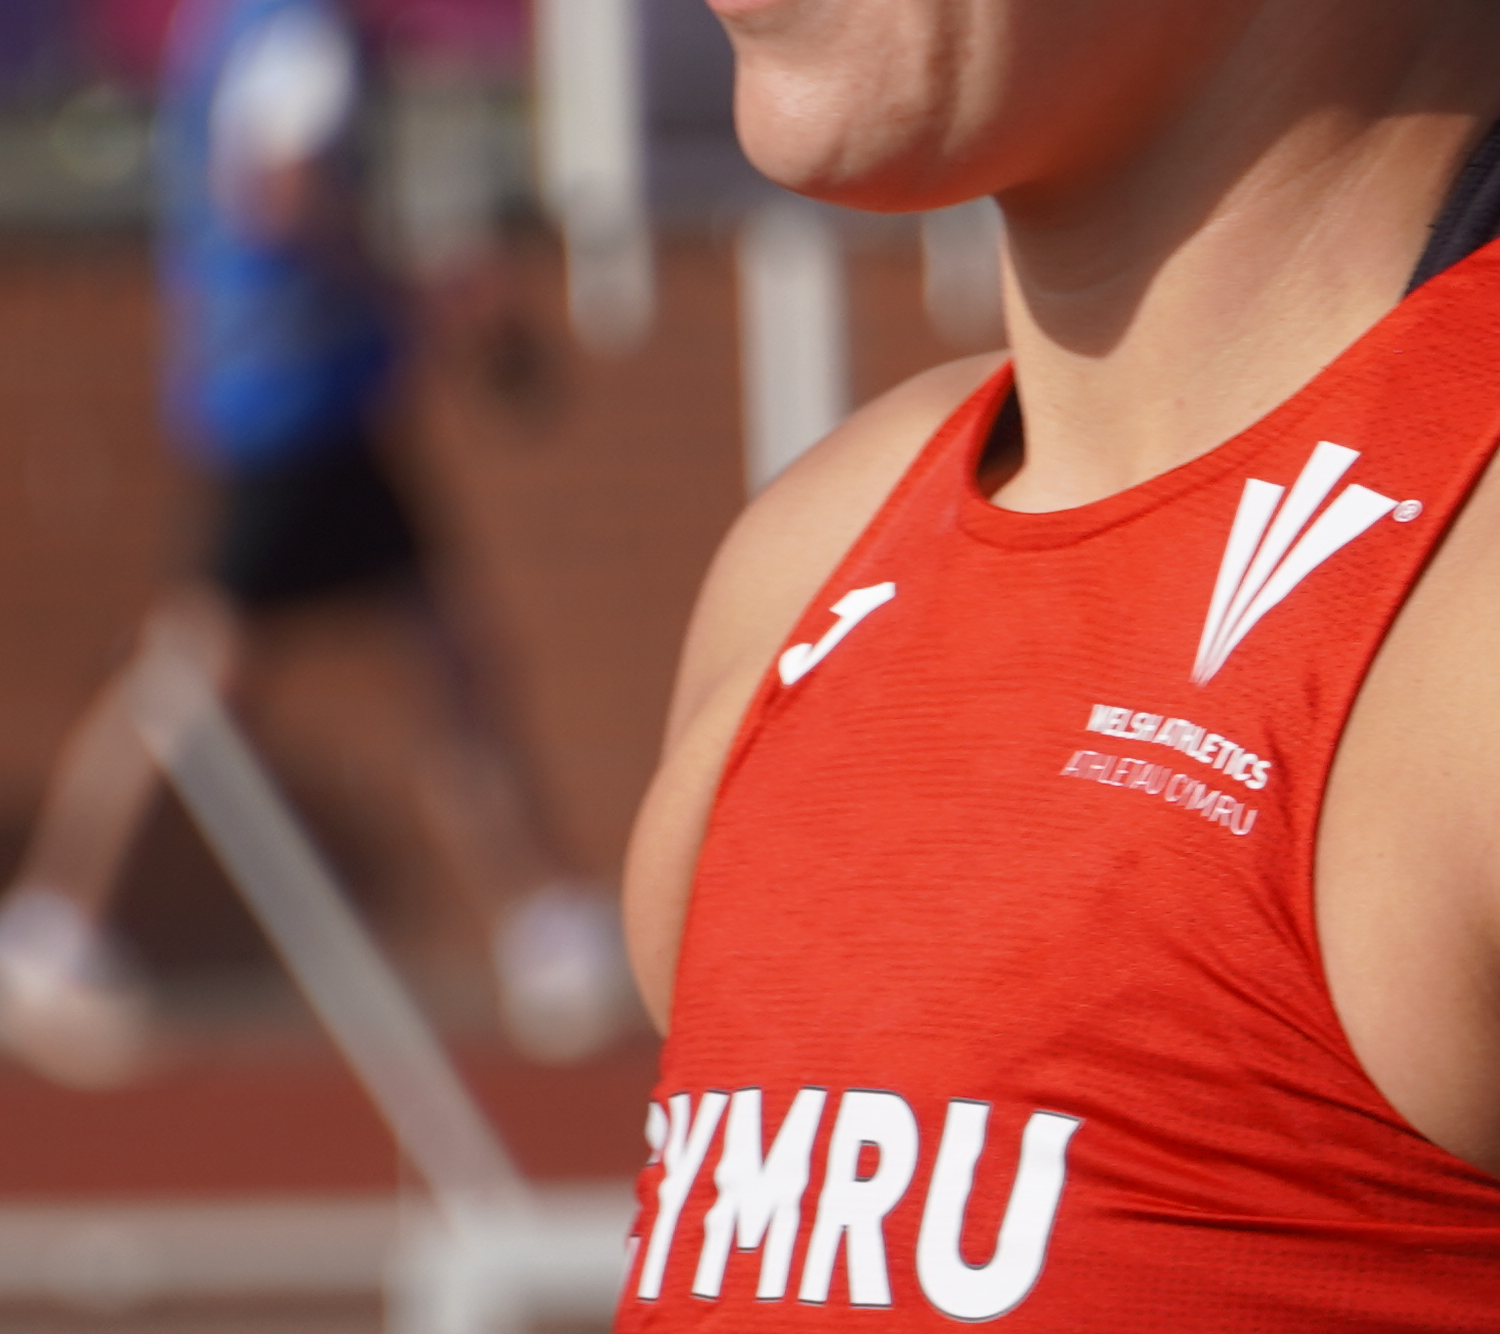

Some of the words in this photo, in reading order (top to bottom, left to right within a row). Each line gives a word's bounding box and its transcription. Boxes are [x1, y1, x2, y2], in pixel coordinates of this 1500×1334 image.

[1086, 703, 1164, 742] WELSH
[1152, 717, 1272, 789] ATHLETICS
[1059, 750, 1172, 795] ATHLETAU
[1164, 773, 1258, 836] CYMRU
